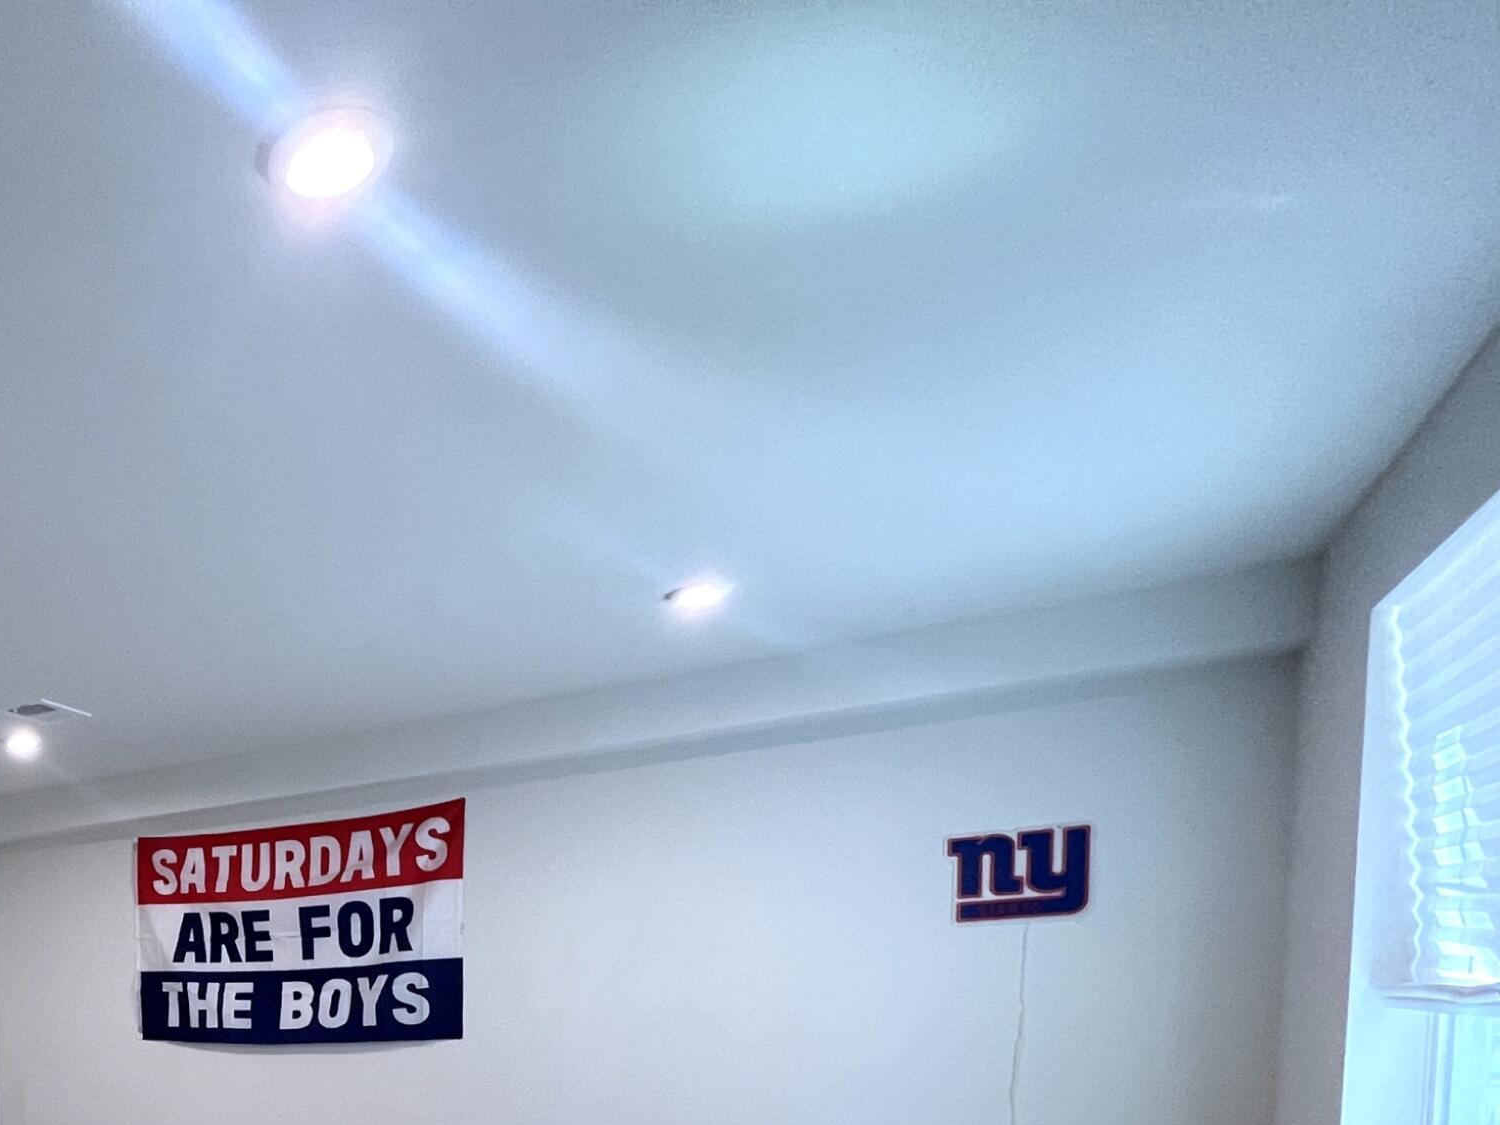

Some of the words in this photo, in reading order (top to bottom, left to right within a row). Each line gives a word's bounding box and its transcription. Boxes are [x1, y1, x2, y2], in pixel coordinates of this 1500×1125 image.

[152, 817, 451, 896] SATURDAYS
[173, 909, 273, 963] ARE
[299, 897, 414, 960] FOR
[162, 981, 254, 1029] THE
[279, 972, 430, 1030] BOYS
